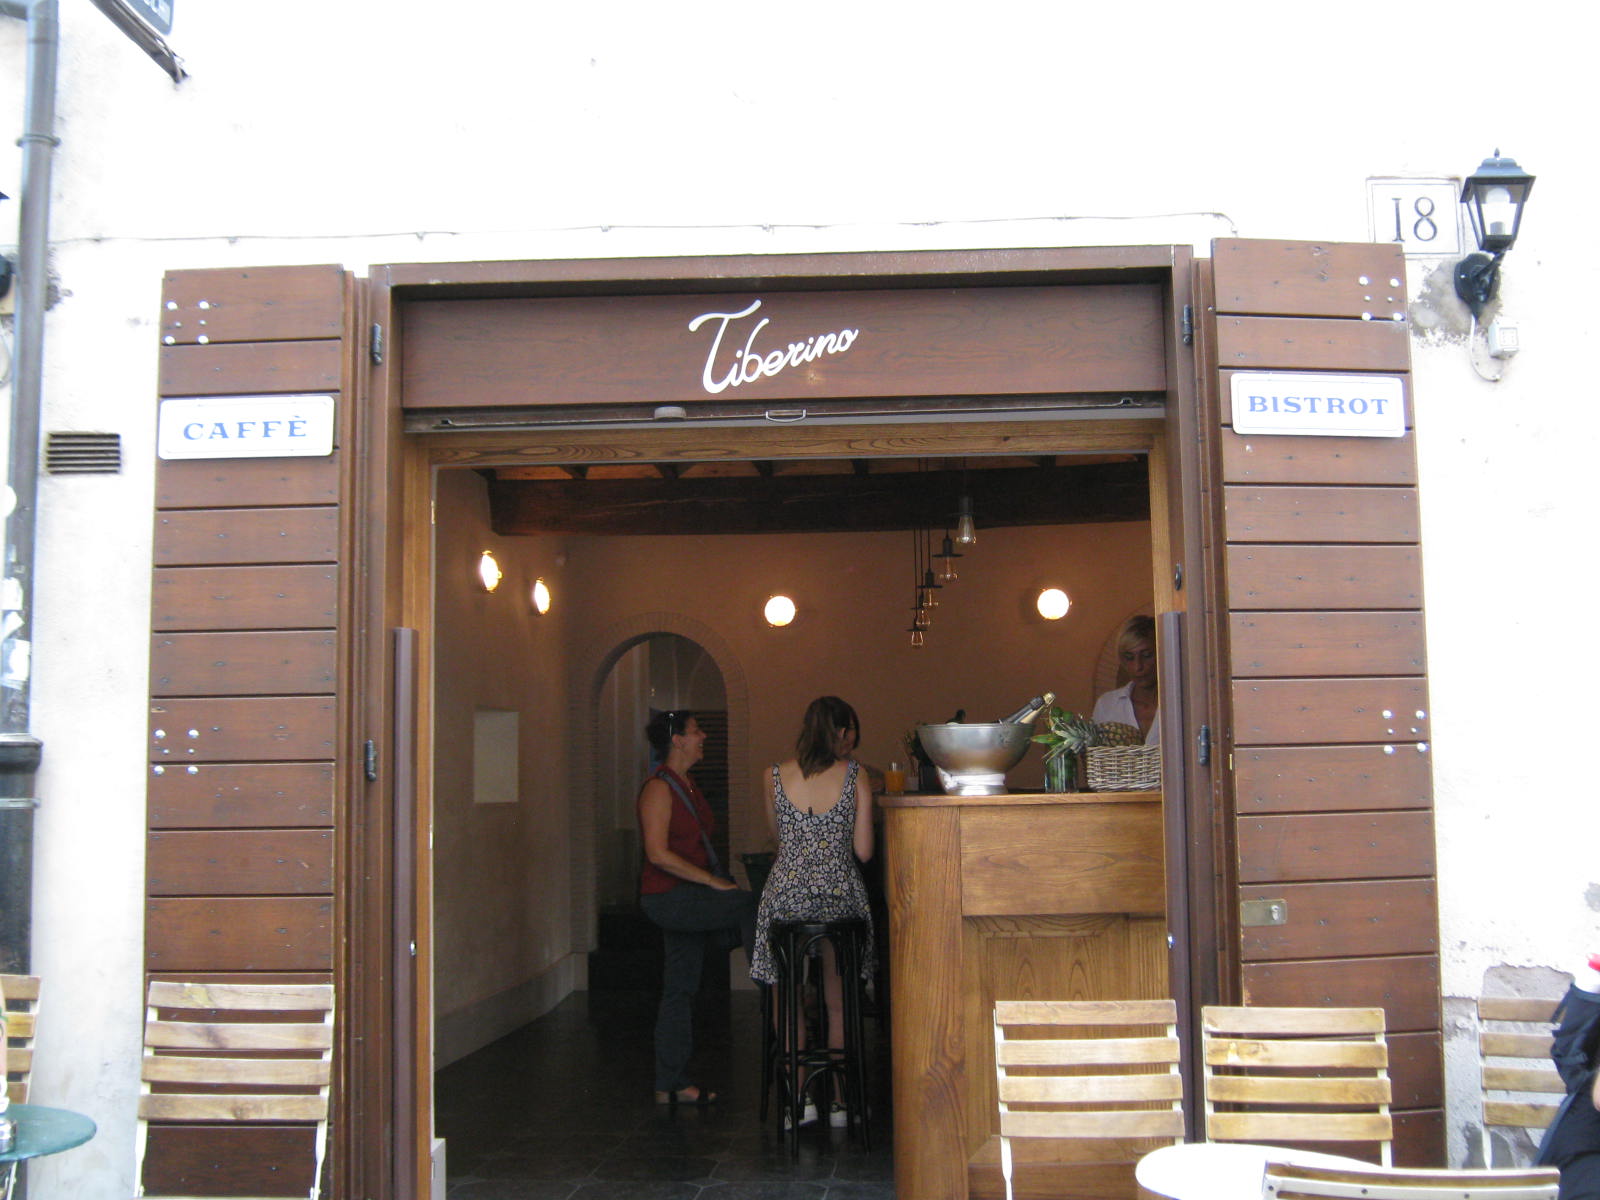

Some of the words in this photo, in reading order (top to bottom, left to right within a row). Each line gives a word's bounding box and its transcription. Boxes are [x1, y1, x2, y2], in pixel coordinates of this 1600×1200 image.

[1391, 196, 1438, 242] 18
[688, 299, 859, 394] Tiberino
[1248, 395, 1389, 415] BISTROT
[183, 415, 307, 440] CAFFÈ
